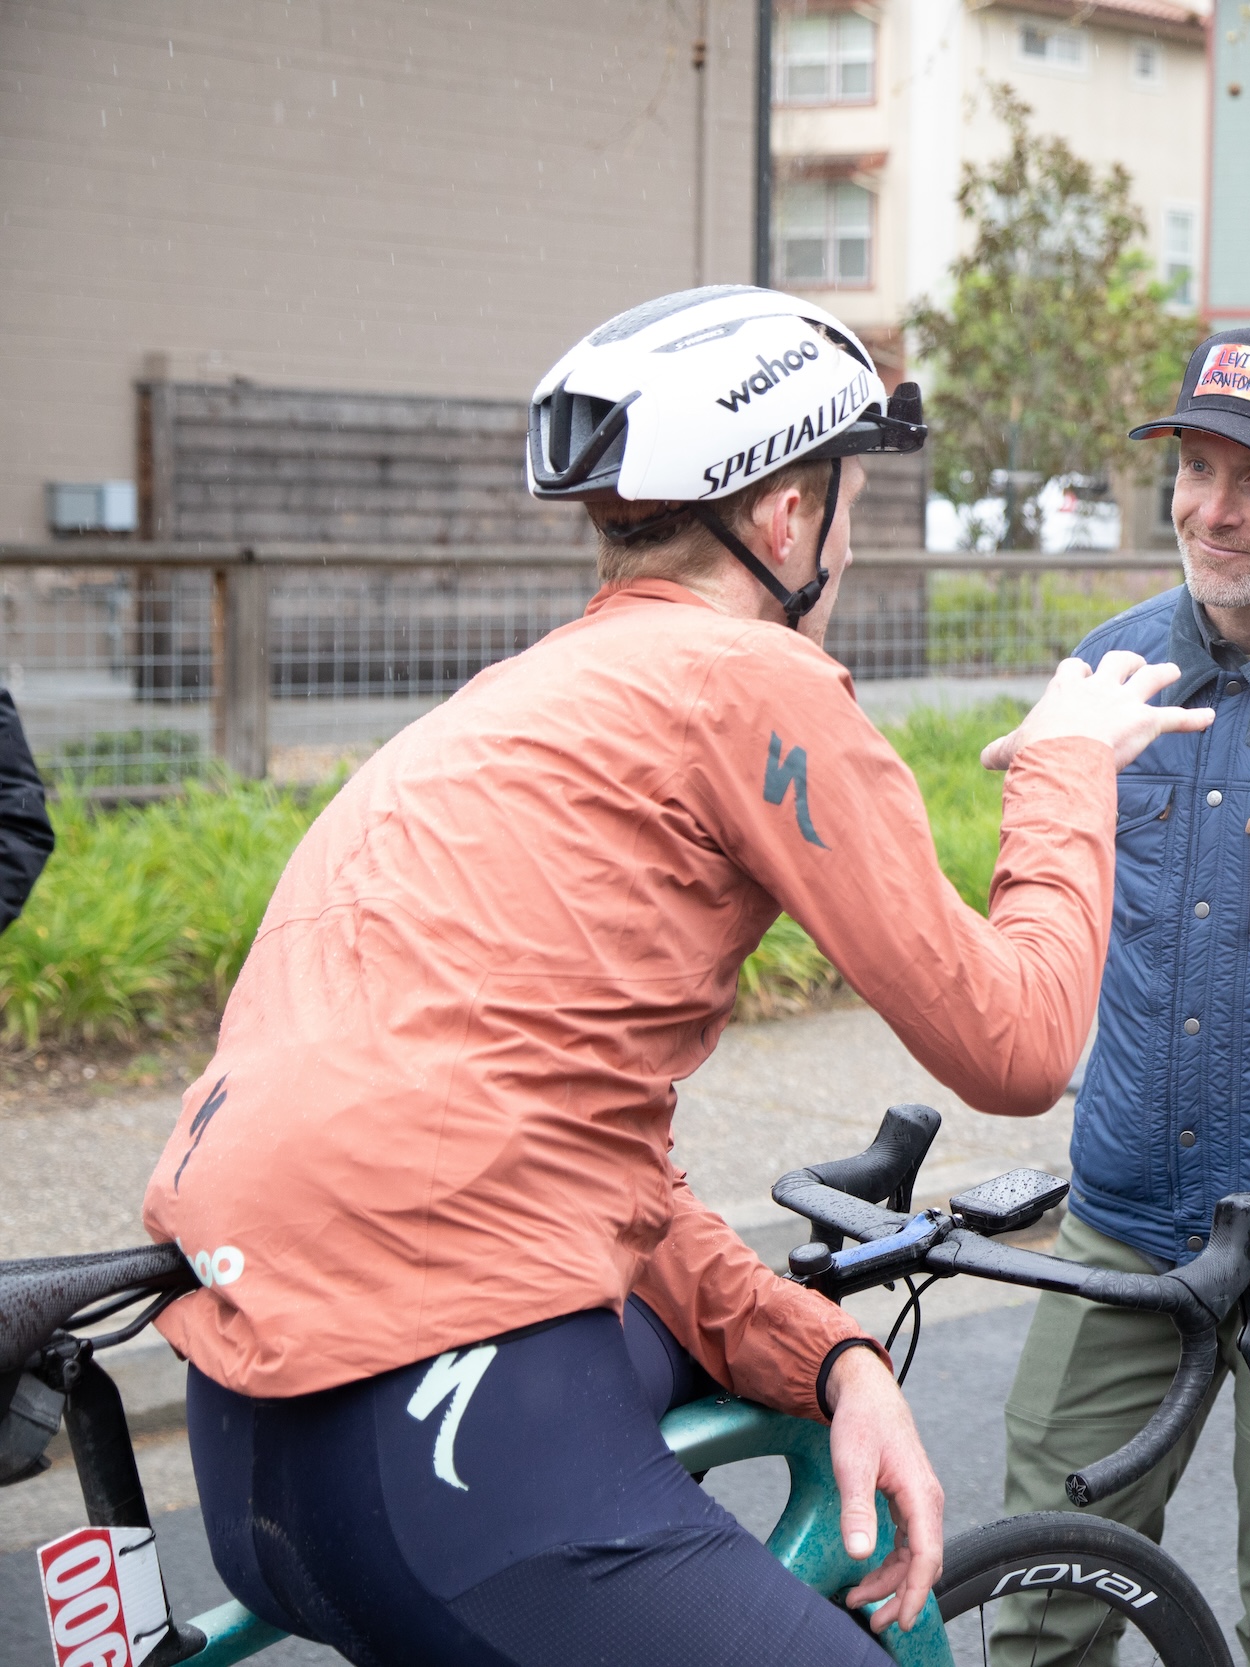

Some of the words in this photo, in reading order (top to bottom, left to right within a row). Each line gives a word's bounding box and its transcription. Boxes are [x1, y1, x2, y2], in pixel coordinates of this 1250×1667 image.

[715, 340, 819, 413] wahoo
[698, 369, 870, 500] SPECIALIZED
[989, 1563, 1159, 1609] roval
